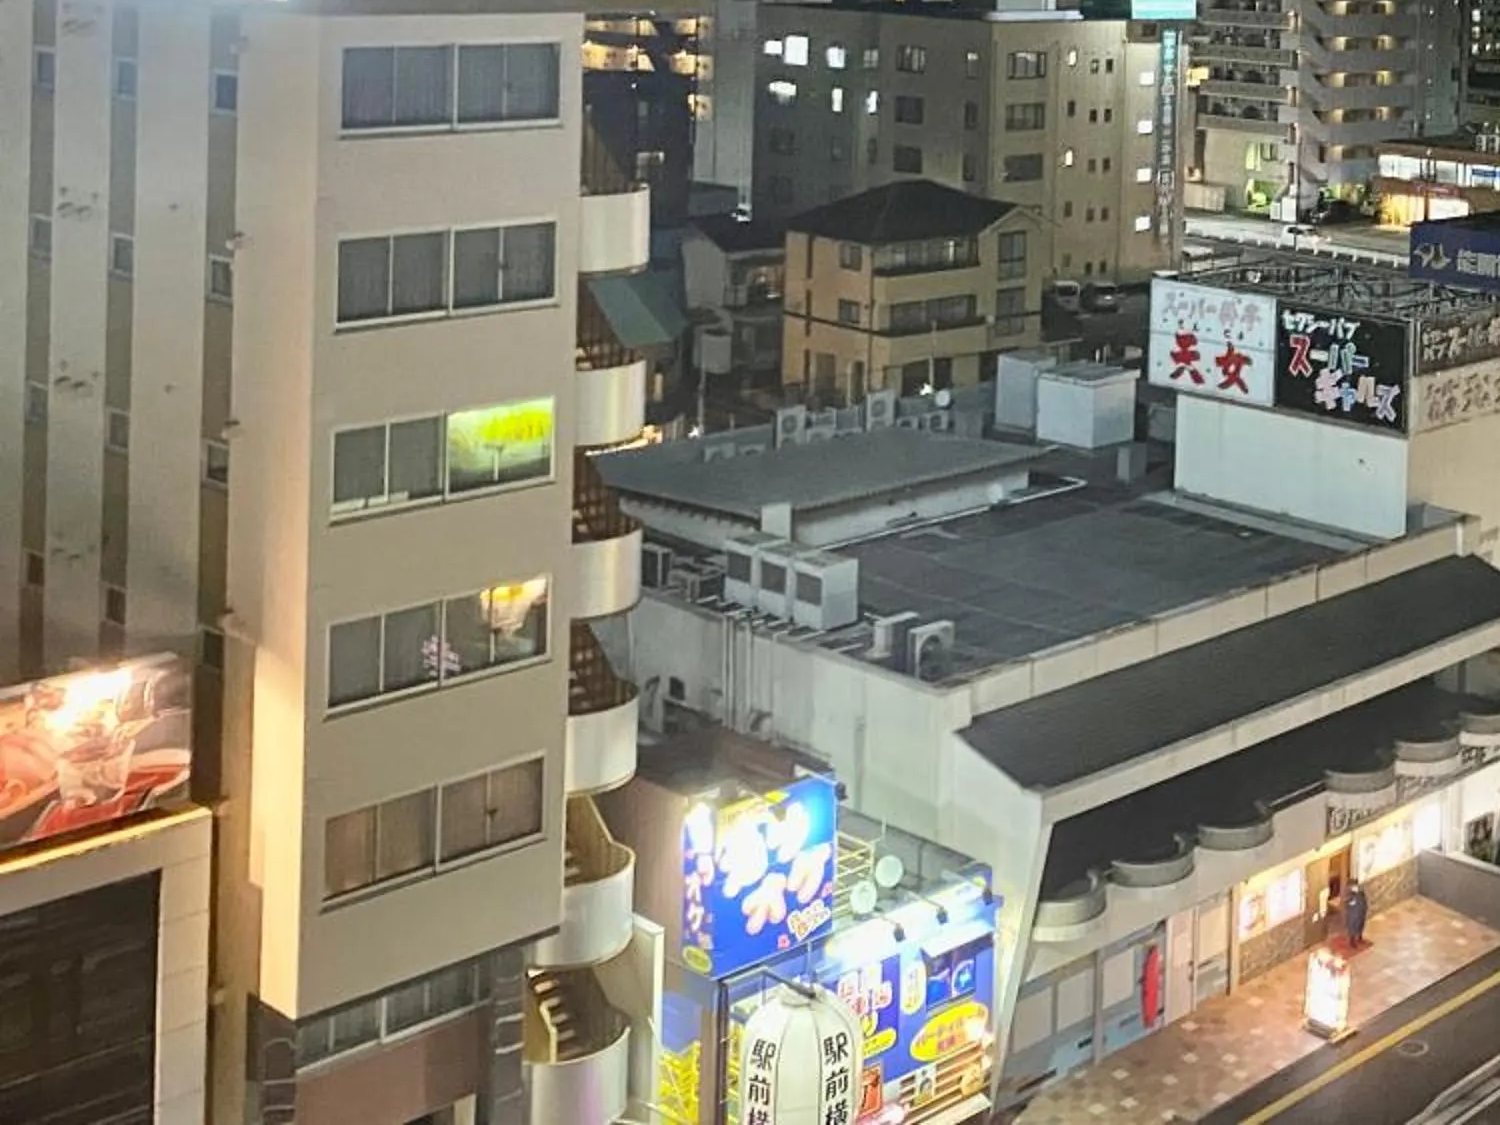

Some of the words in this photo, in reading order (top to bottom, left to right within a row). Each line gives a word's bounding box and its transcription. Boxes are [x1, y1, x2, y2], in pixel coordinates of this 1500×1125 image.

[1170, 332, 1254, 394] 天女
[1289, 334, 1369, 378] スーパー
